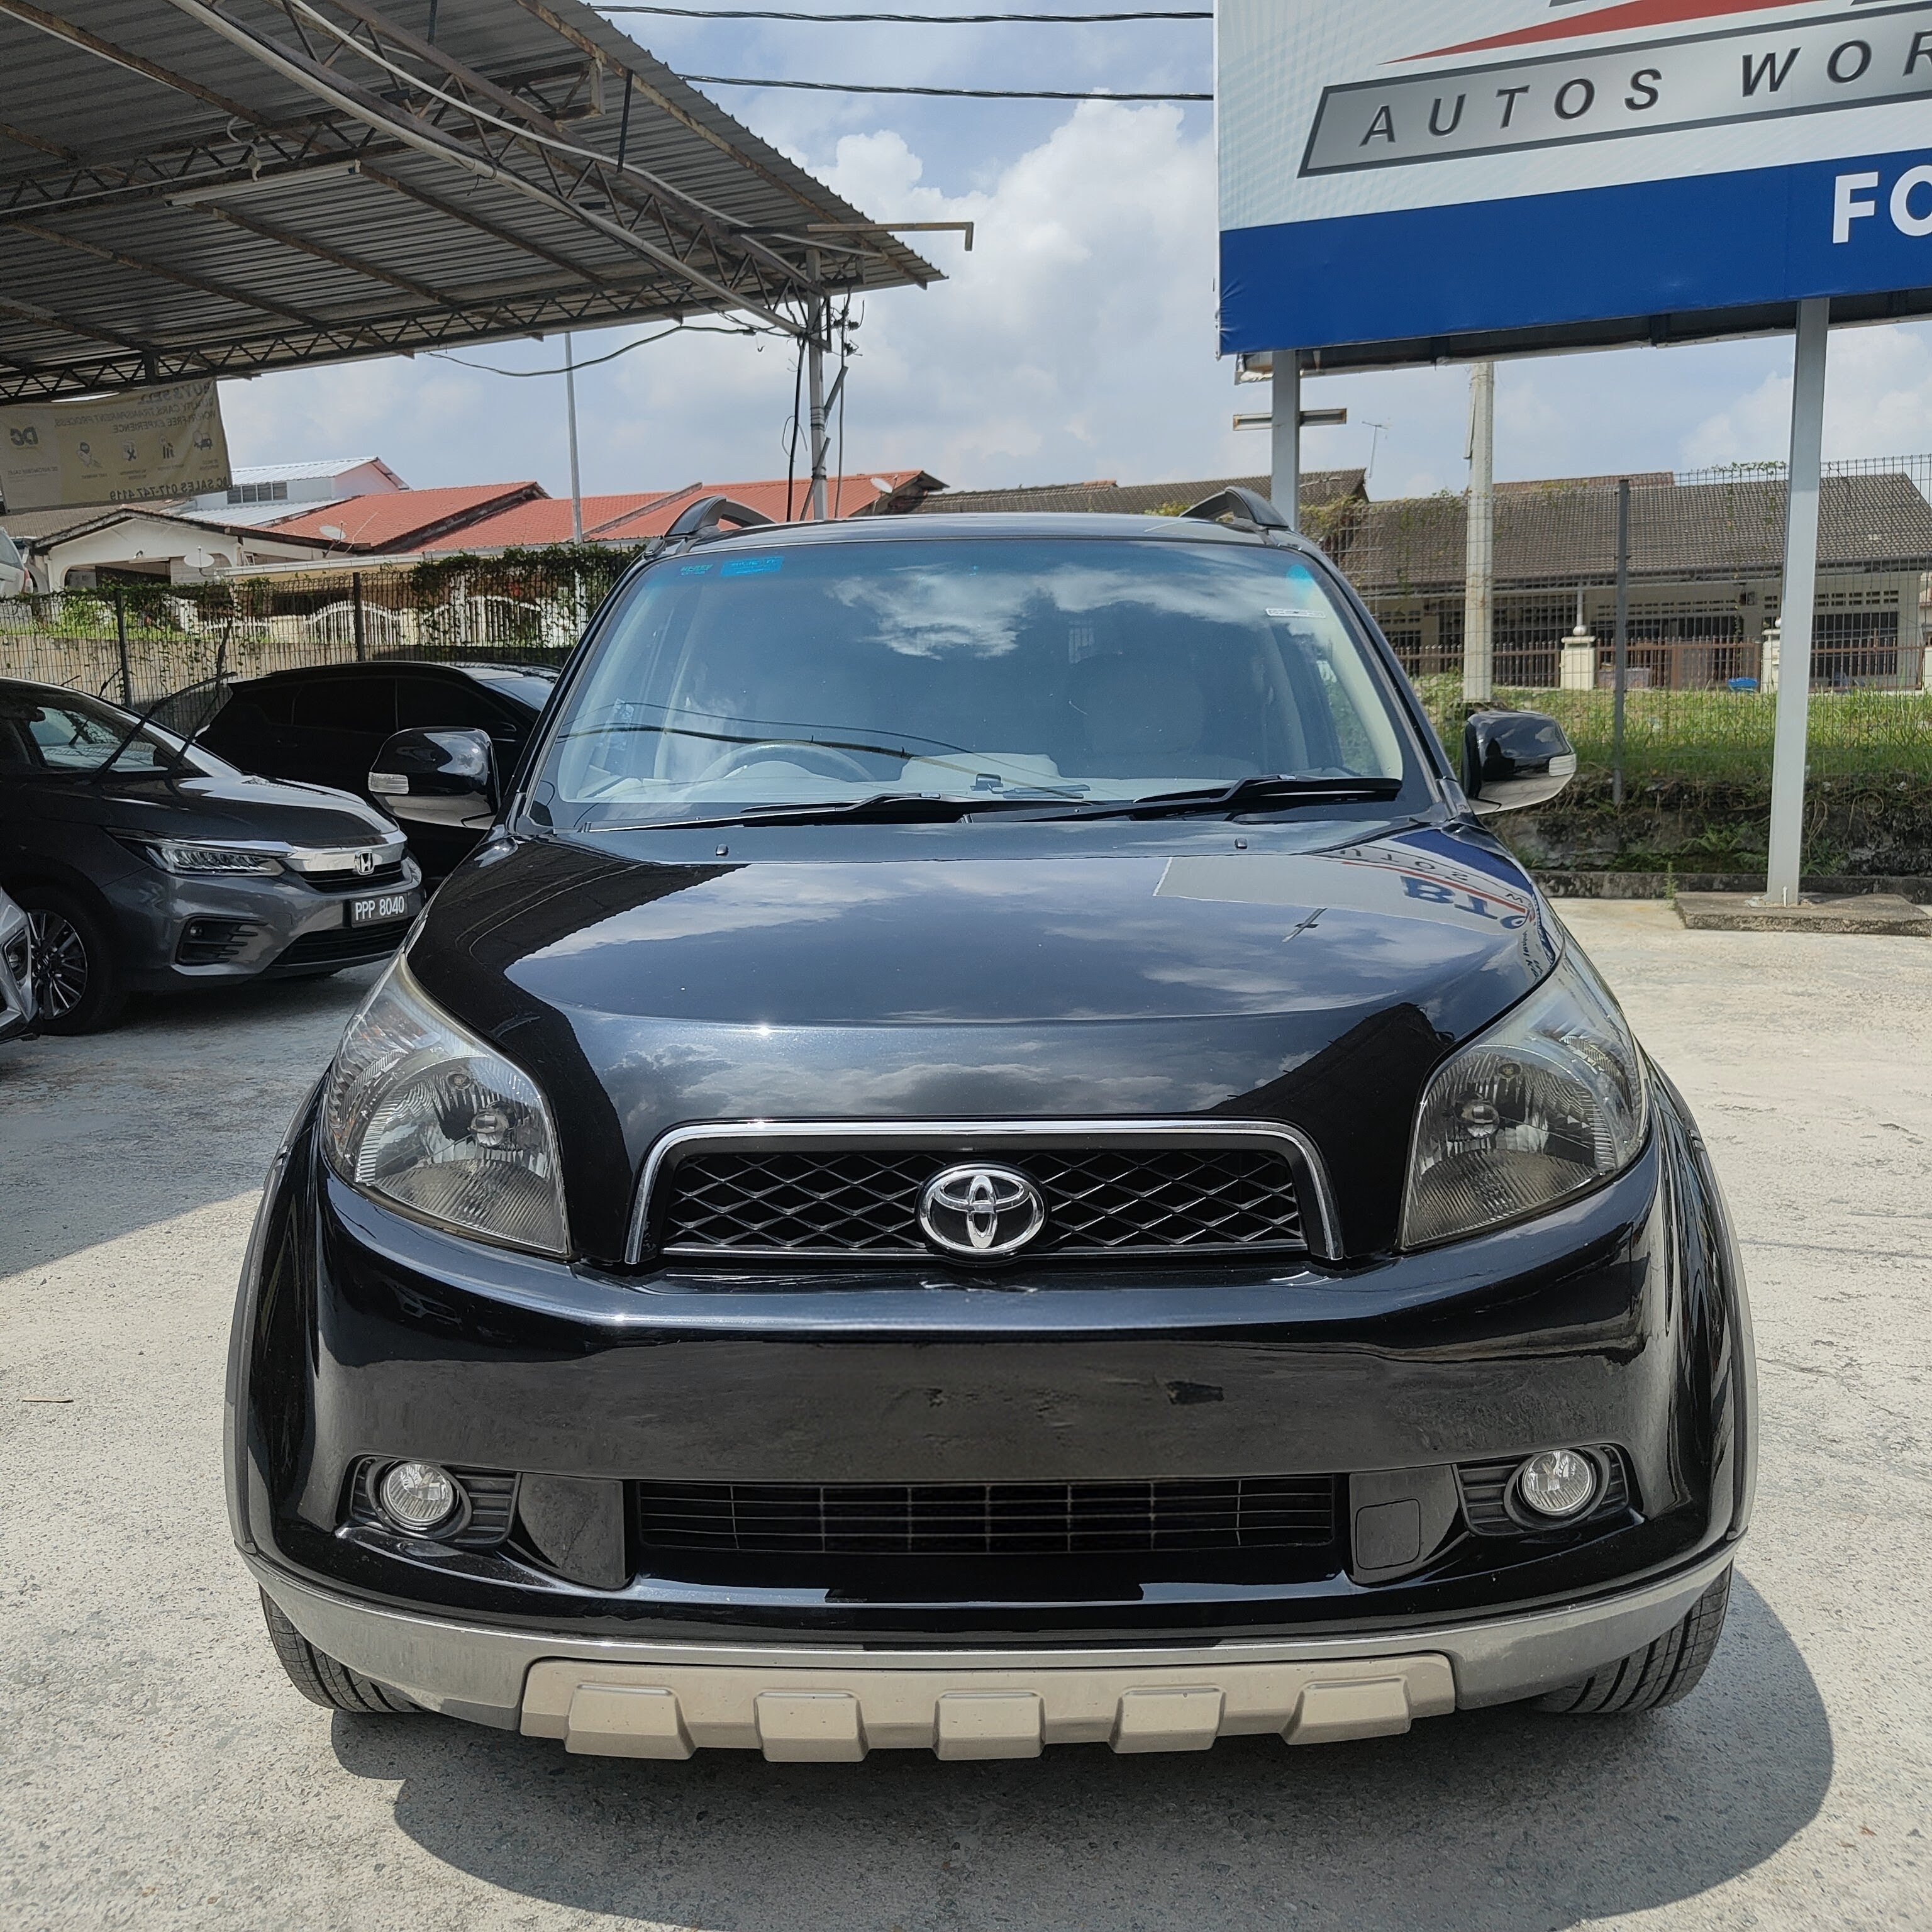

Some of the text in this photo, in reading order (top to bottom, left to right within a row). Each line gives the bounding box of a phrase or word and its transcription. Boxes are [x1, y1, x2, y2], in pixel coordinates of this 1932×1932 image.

[1359, 68, 1662, 147] AUTOS
[355, 896, 404, 921] PPP 8040
